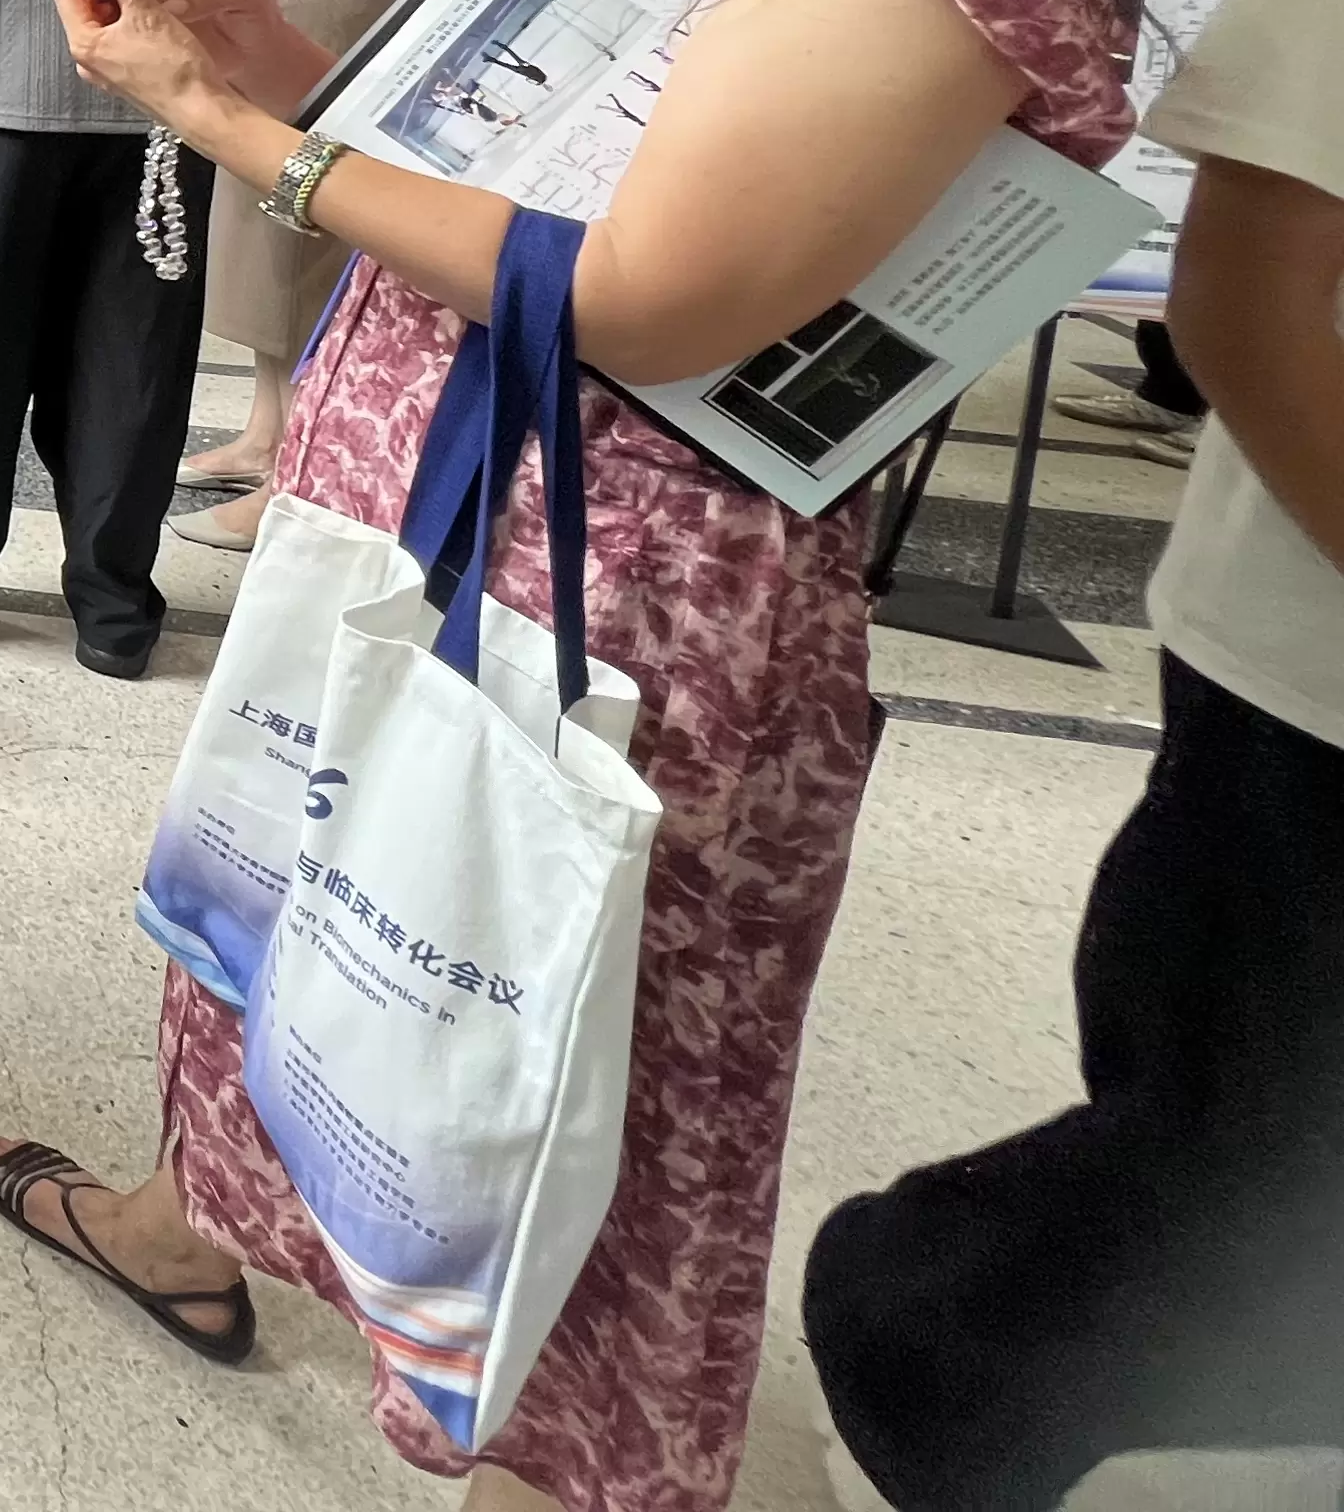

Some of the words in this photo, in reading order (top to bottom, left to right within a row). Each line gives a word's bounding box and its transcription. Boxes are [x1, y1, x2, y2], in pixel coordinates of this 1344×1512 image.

[295, 849, 525, 1016] 与临床转化会议
[295, 904, 318, 924] on
[323, 918, 431, 1015] Biomechanics
[310, 931, 388, 1010] Translation
